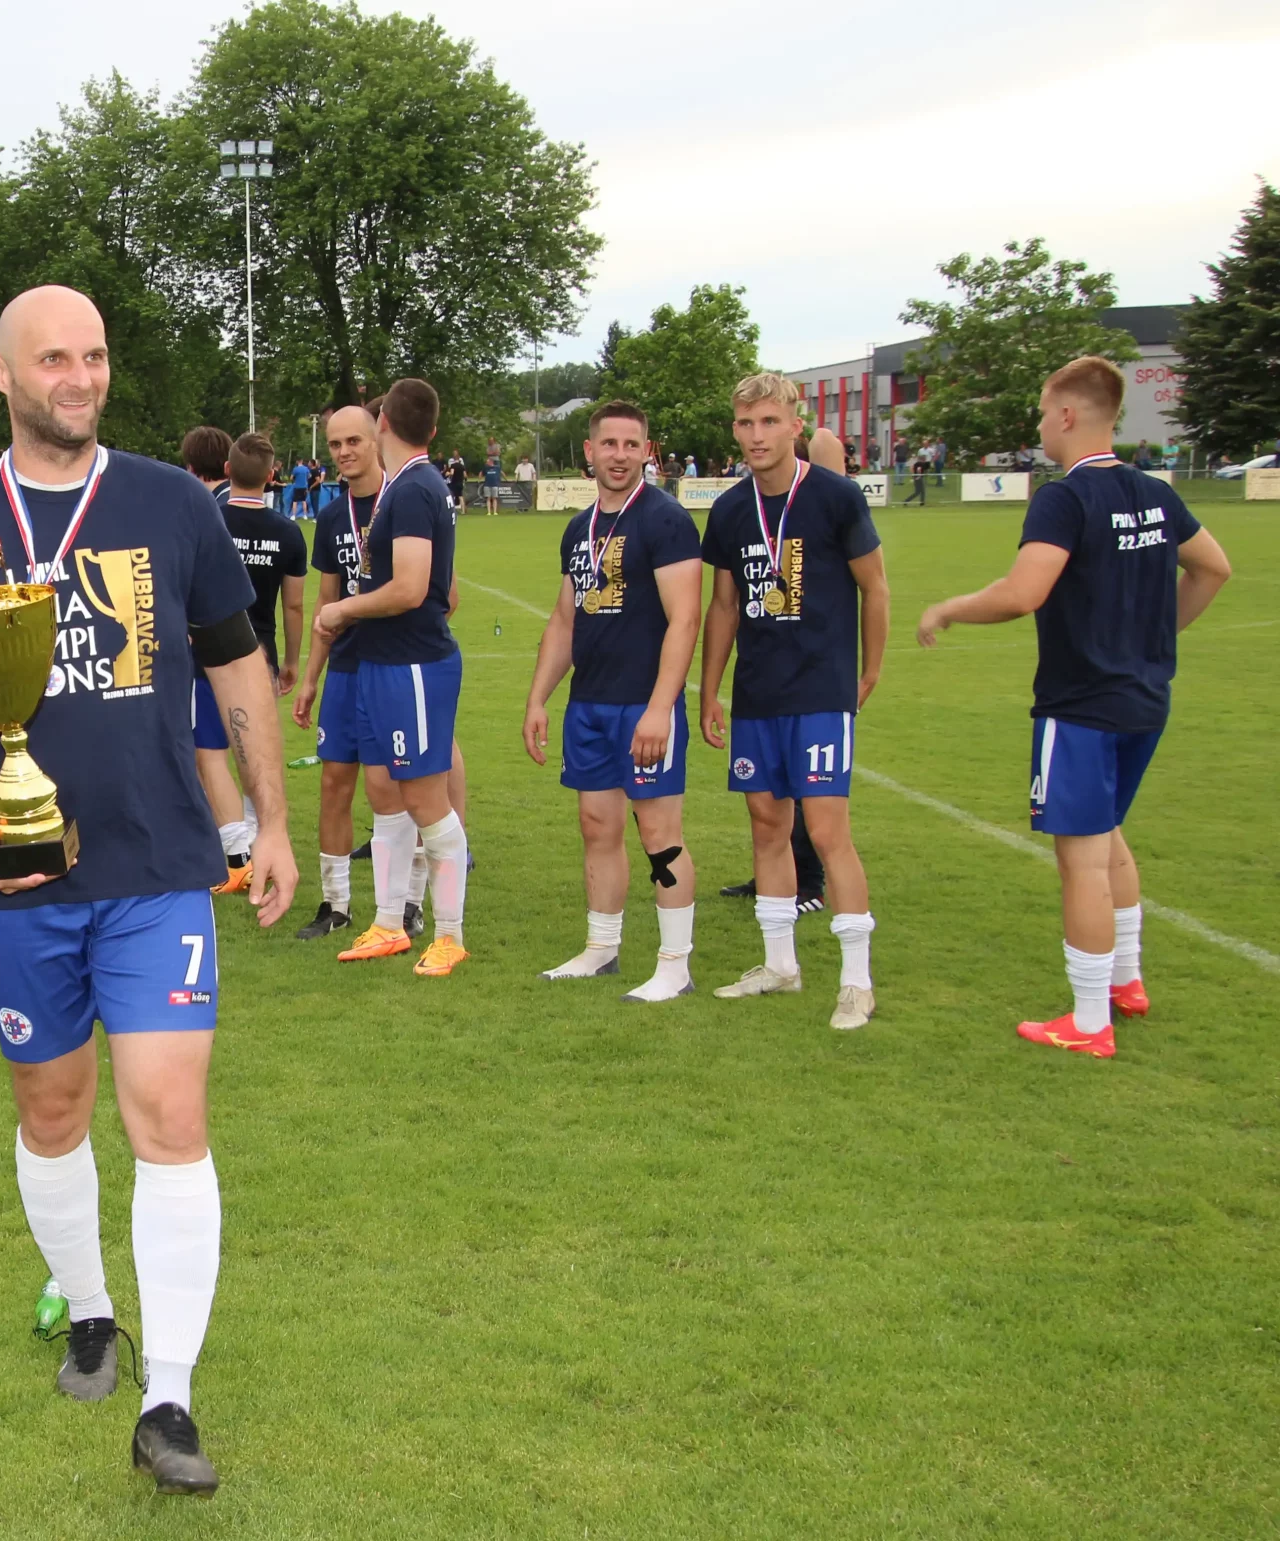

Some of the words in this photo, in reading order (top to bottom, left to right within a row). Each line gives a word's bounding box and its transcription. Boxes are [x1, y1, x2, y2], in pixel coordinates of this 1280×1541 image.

[612, 535, 627, 607] DUBRAVČAN
[789, 538, 805, 616] DUBRAVČAN
[130, 547, 160, 686] DUBRAVČAN
[391, 730, 407, 757] 8
[805, 744, 835, 772] 11
[1030, 774, 1046, 805] 4
[181, 934, 205, 986] 7
